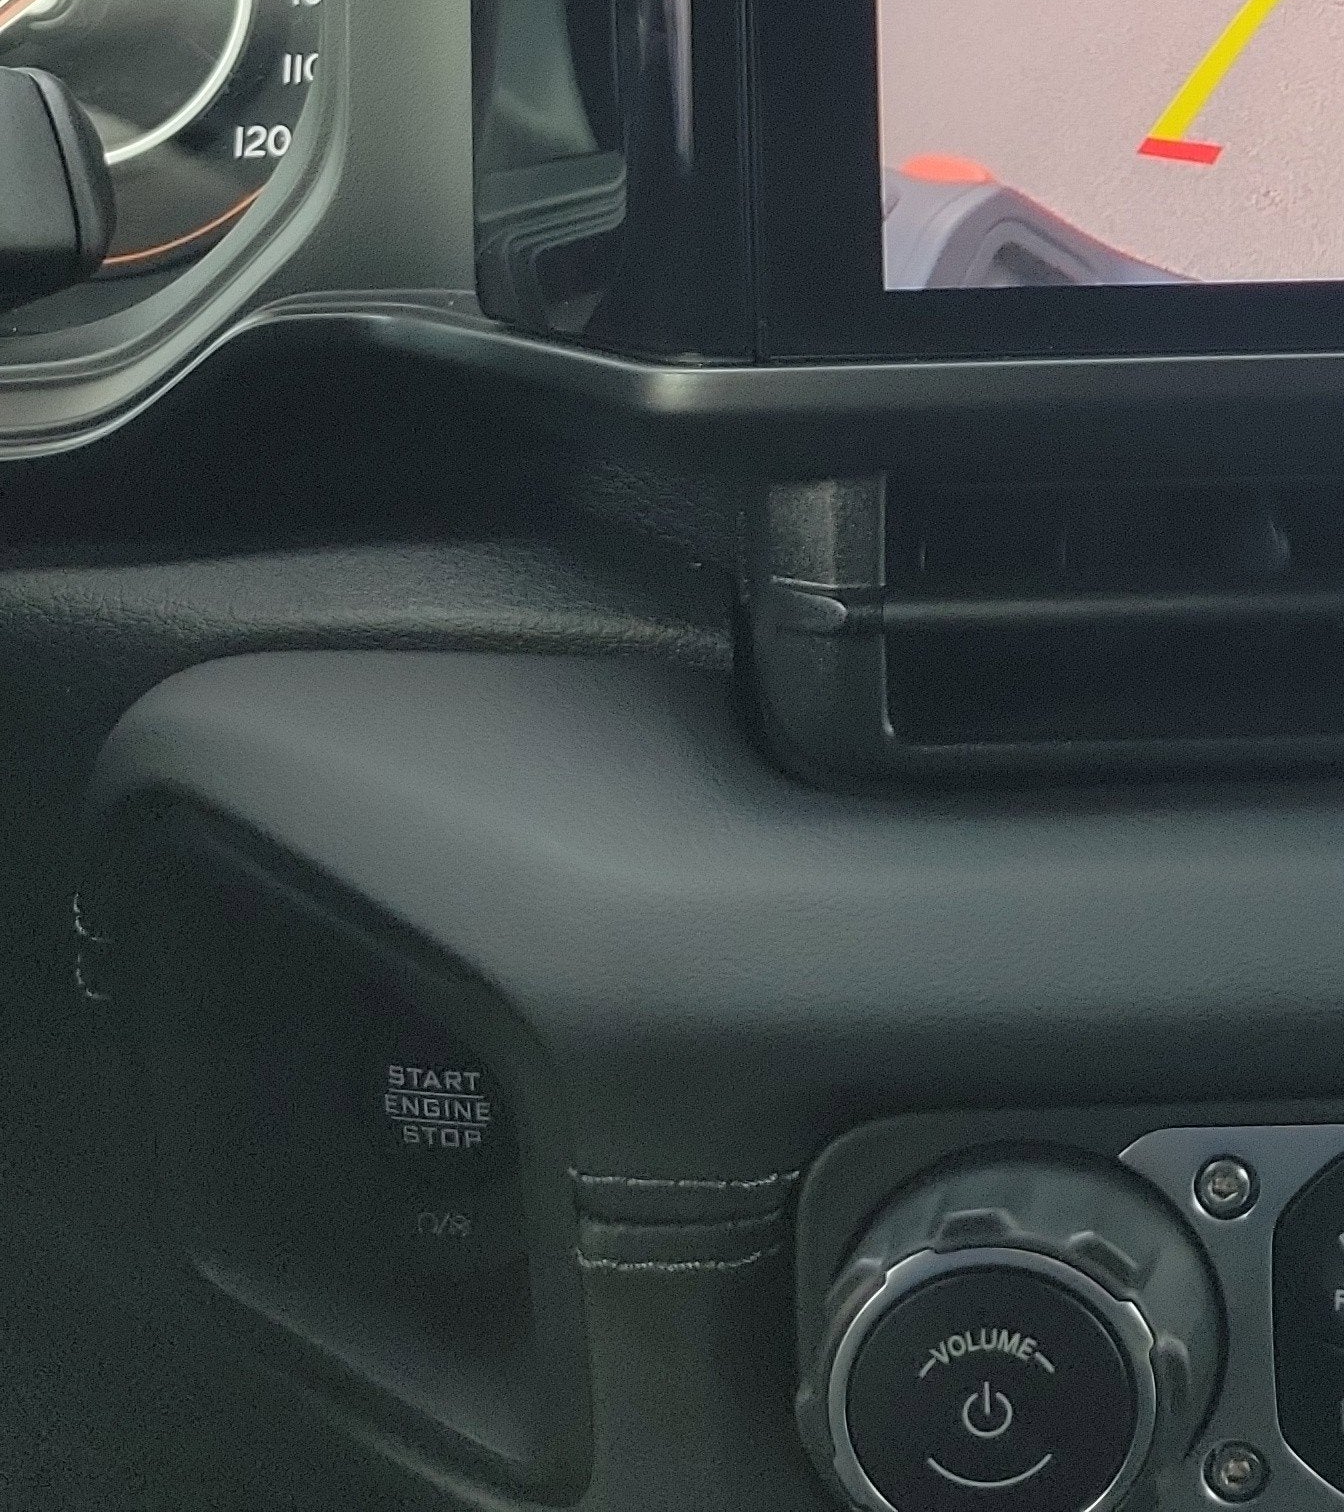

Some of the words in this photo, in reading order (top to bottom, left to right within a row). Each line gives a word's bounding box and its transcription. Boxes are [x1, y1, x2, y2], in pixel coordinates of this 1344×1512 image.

[233, 125, 292, 158] 120
[388, 1065, 480, 1091] START
[384, 1093, 491, 1121] ENGINE
[403, 1125, 482, 1148] STOP
[928, 1328, 1037, 1365] VOLUME
